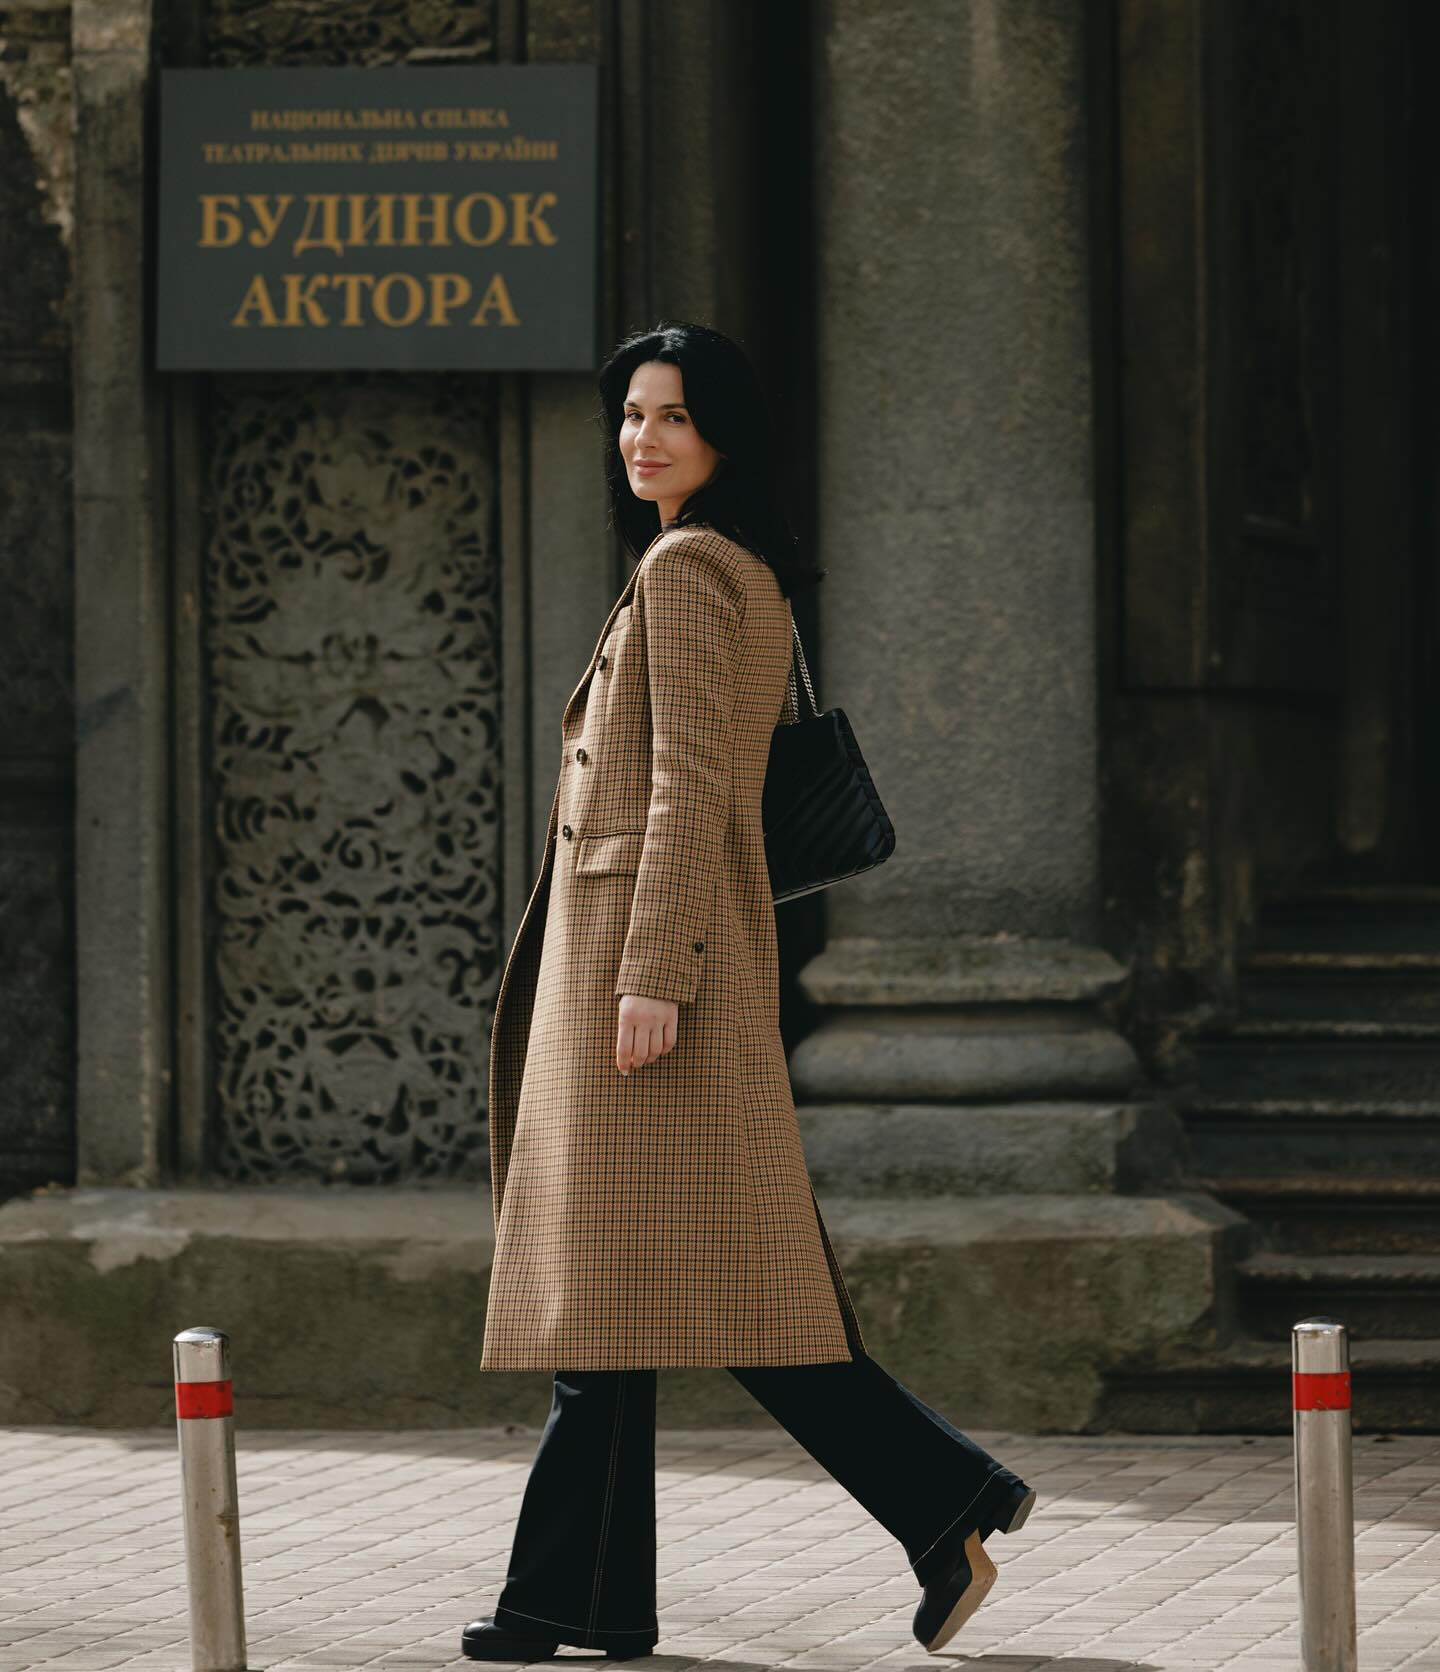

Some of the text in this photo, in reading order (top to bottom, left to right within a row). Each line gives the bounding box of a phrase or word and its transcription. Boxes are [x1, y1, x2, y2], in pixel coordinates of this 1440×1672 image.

[421, 108, 509, 129] СПІЛКА
[198, 192, 558, 256] БУДИНОК
[231, 272, 520, 326] АКТОРА
